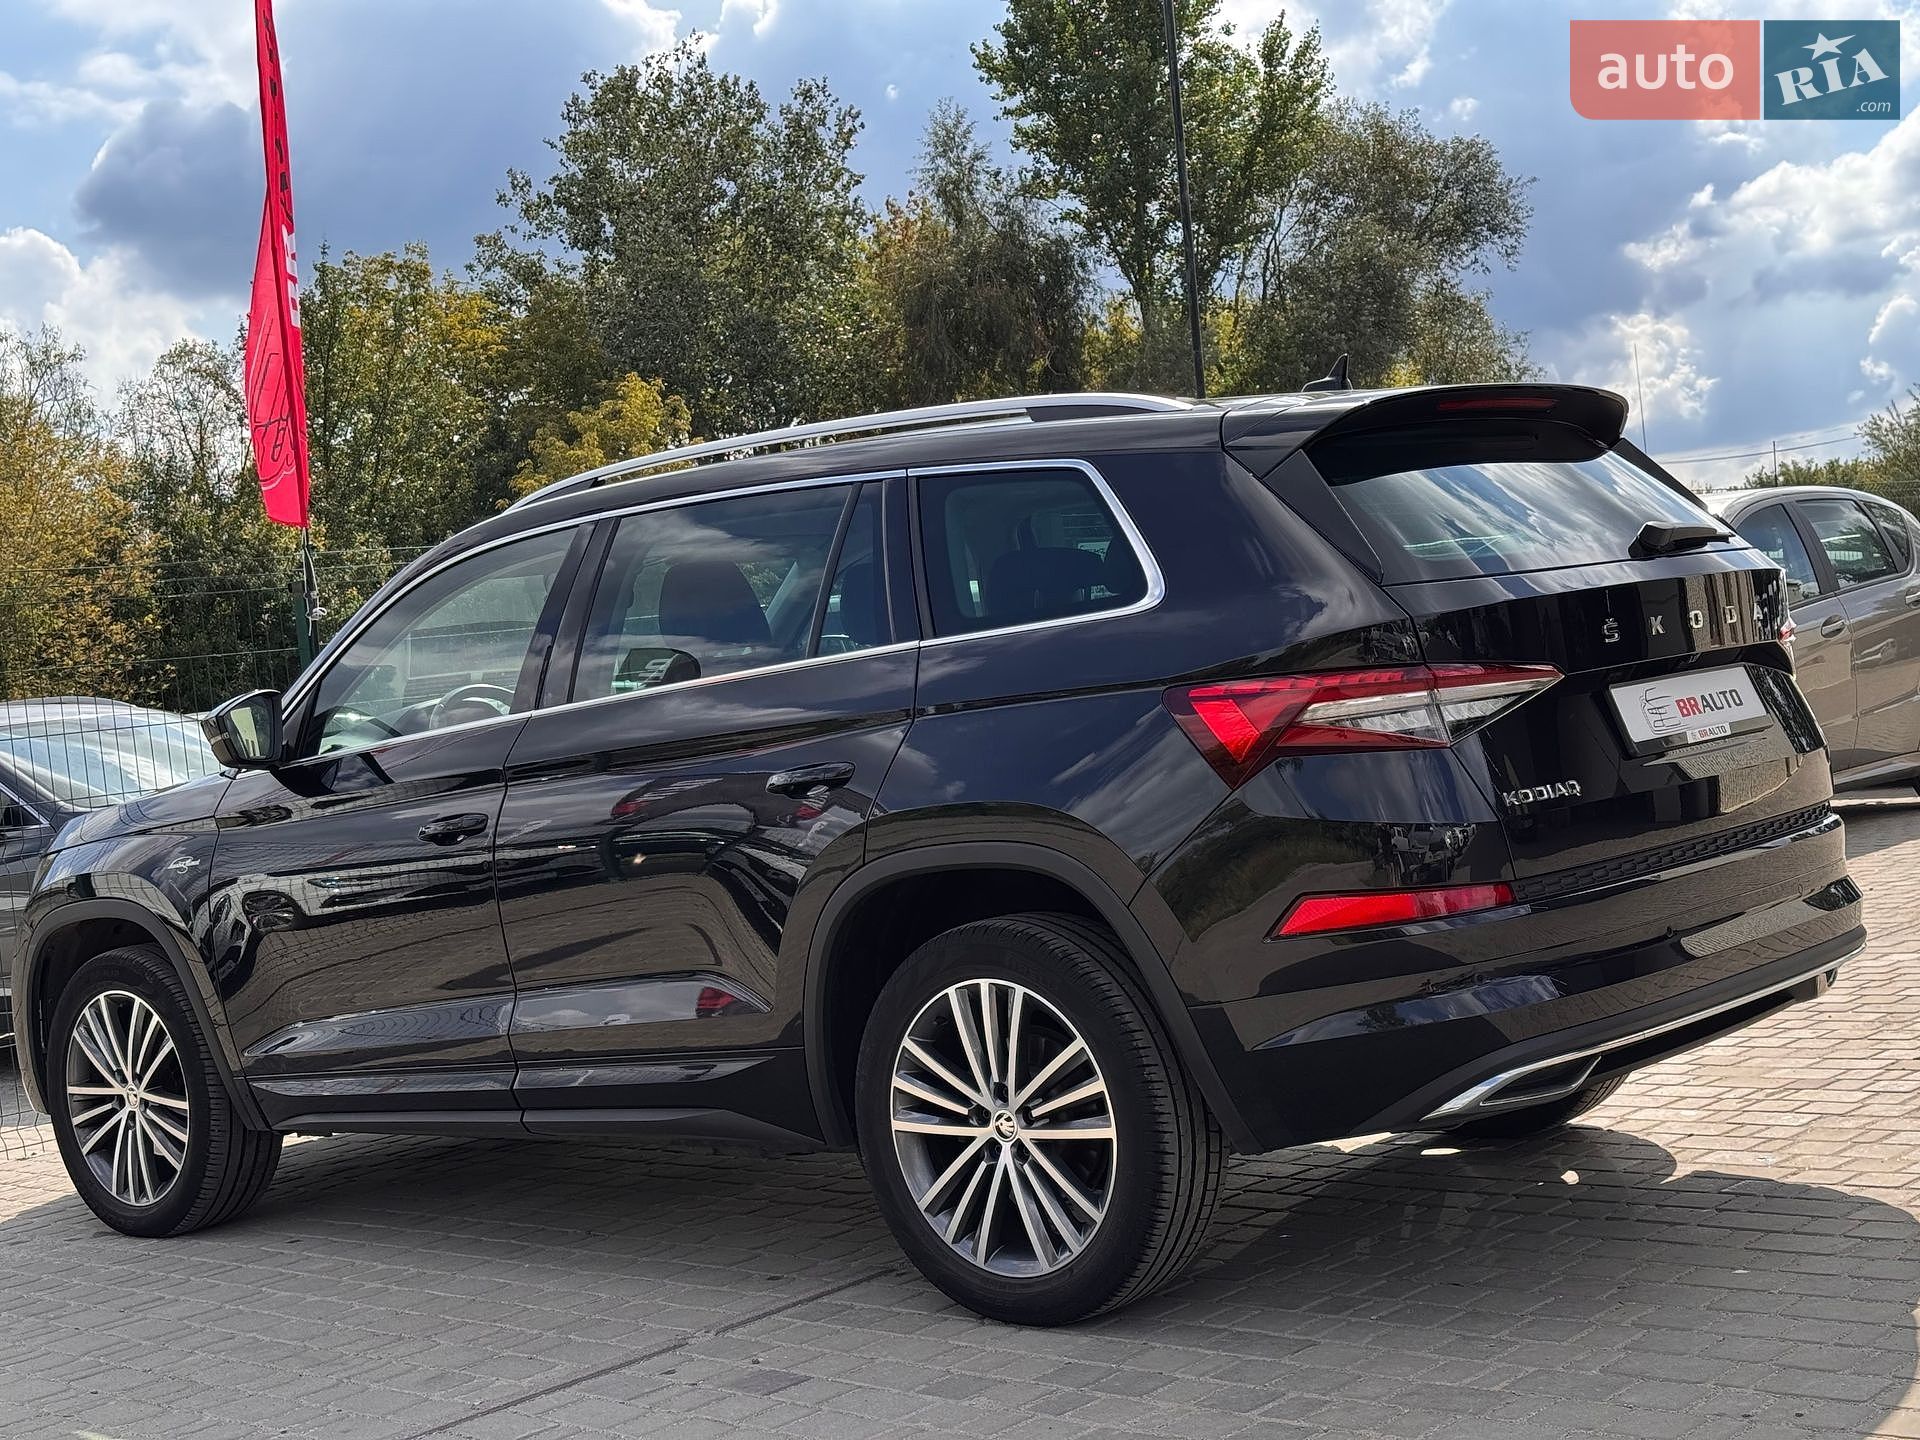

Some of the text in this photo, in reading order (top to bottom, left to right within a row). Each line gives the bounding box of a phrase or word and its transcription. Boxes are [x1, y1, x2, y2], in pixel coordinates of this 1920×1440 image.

[1675, 688, 1744, 718] BRAUTO
[1697, 725, 1727, 739] BRAUTO
[1503, 780, 1581, 807] KODIAQ
